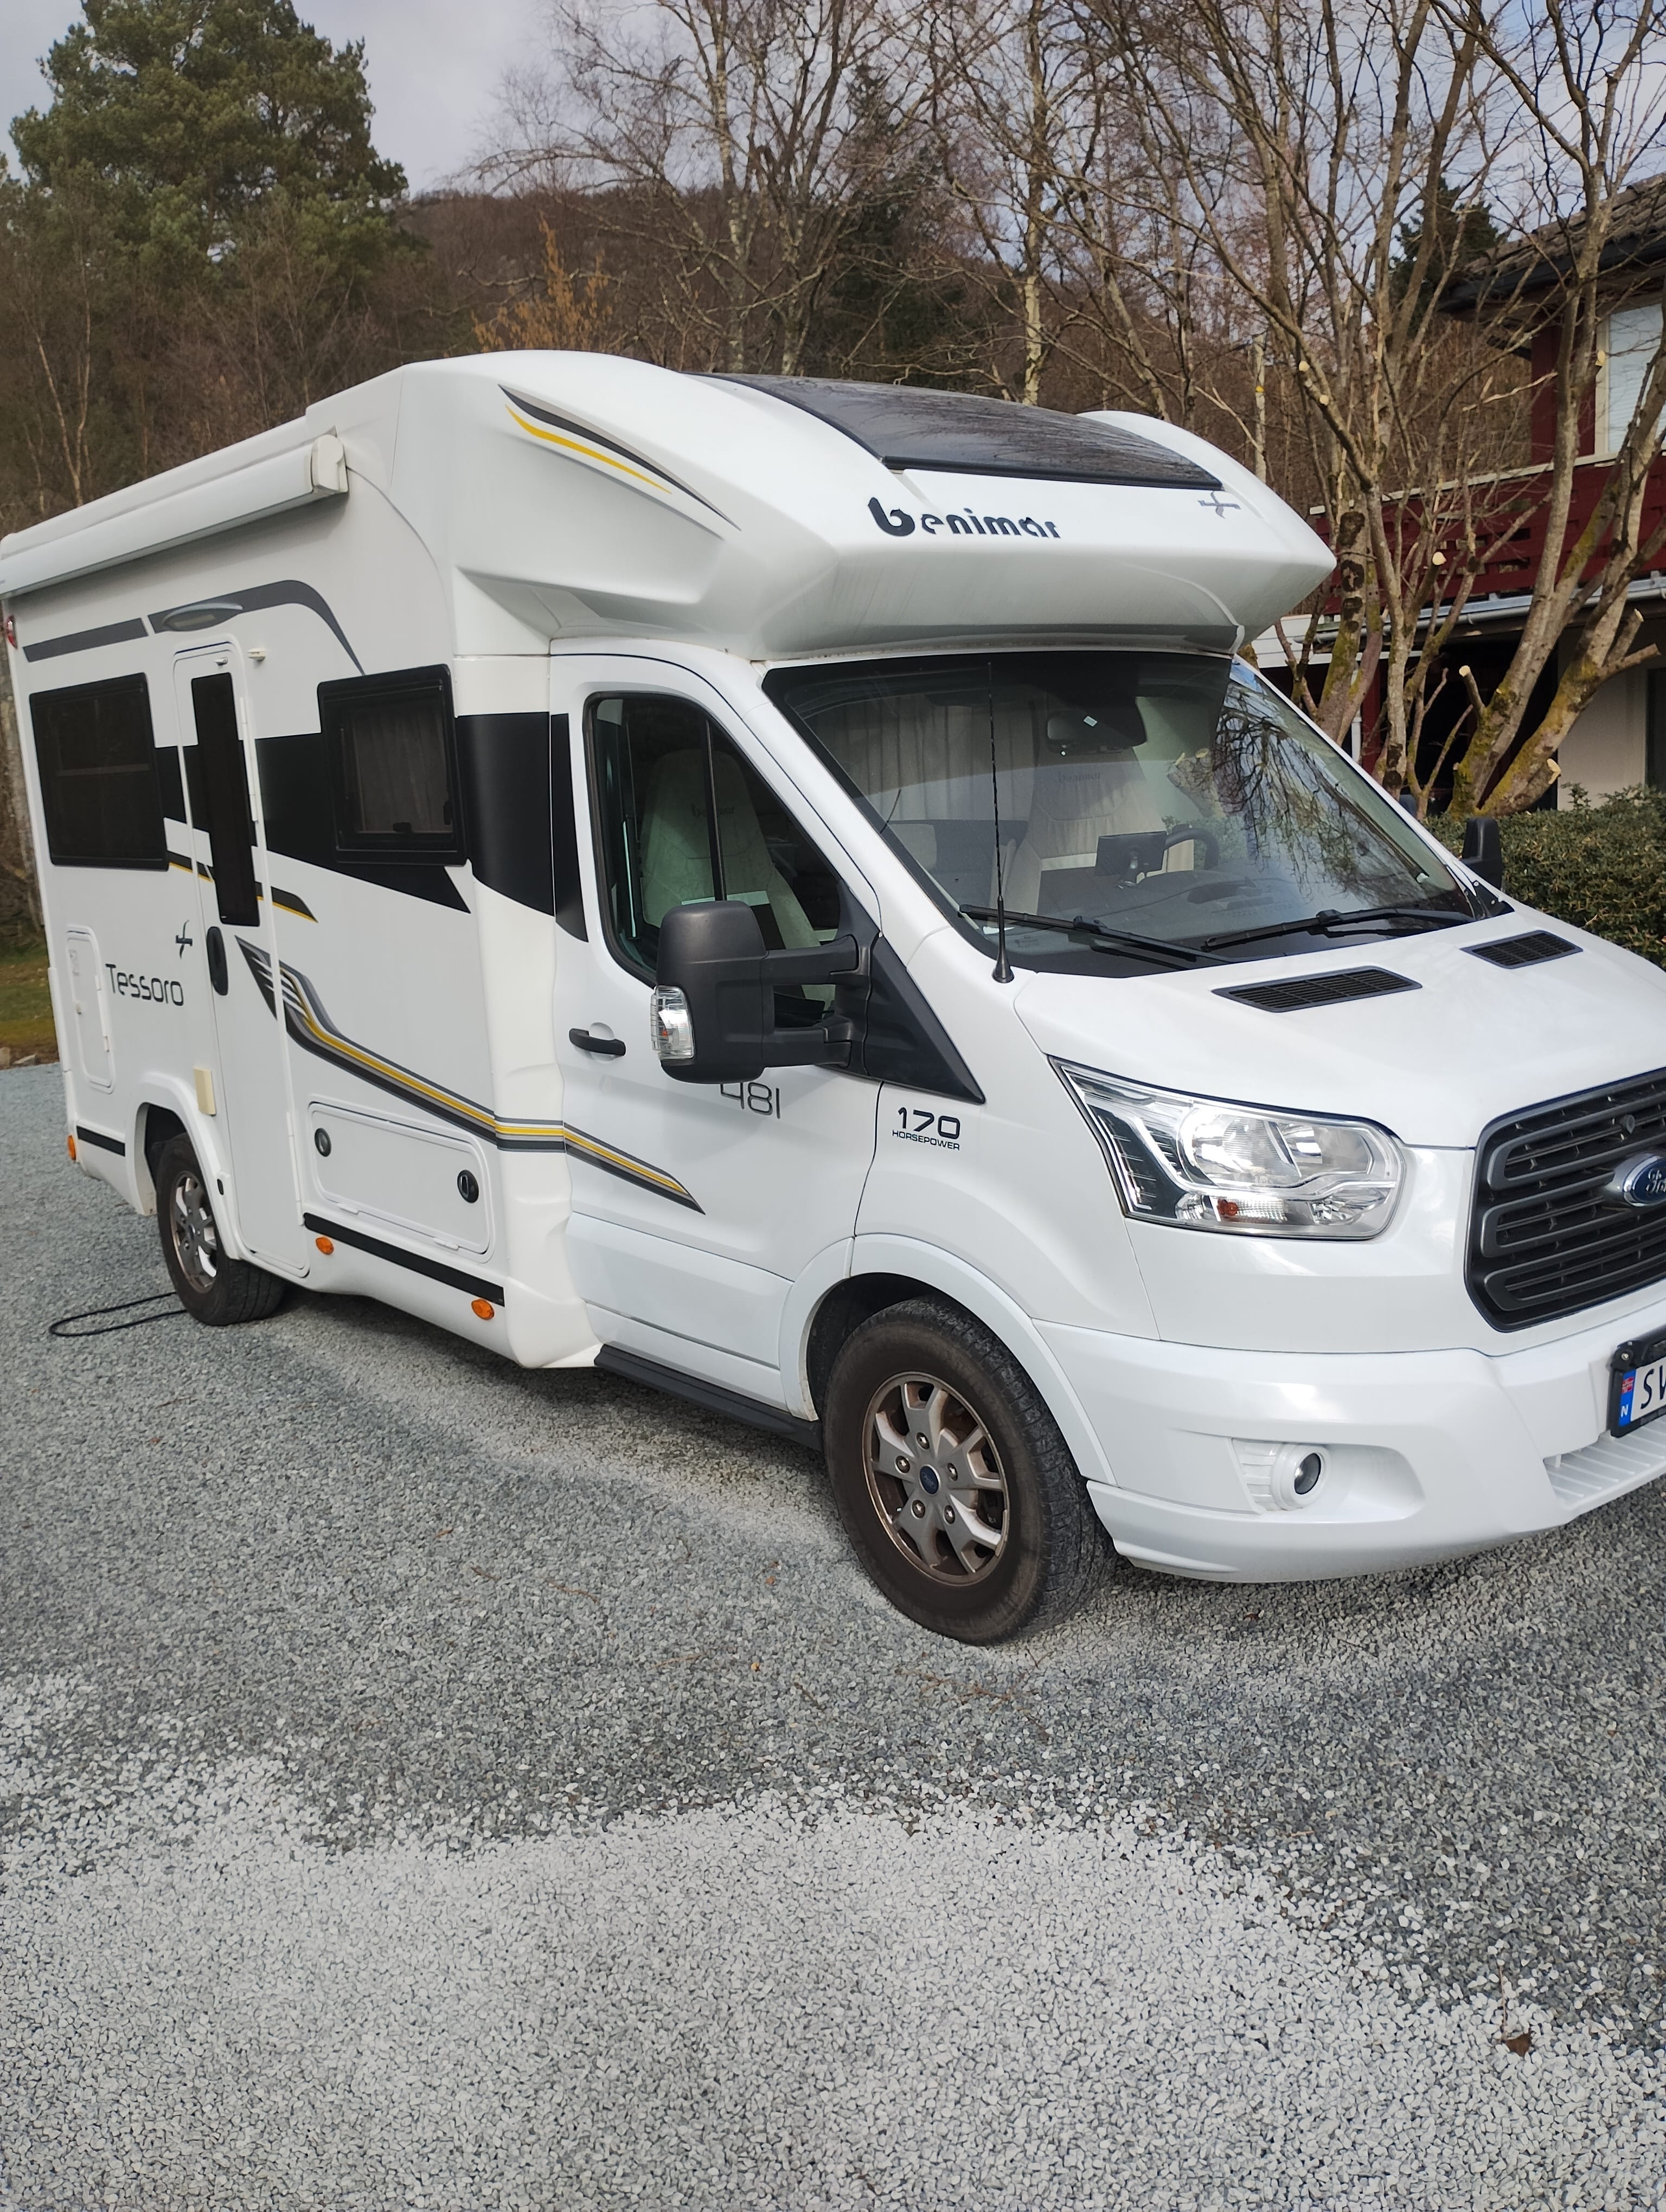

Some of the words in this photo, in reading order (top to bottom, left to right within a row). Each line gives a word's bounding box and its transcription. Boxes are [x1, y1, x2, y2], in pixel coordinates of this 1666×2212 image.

[867, 496, 1061, 537] benimar
[105, 963, 184, 1006] Tessoro
[892, 1129, 960, 1151] HORSEPOWER
[898, 1107, 961, 1140] 170
[1620, 1404, 1629, 1418] N
